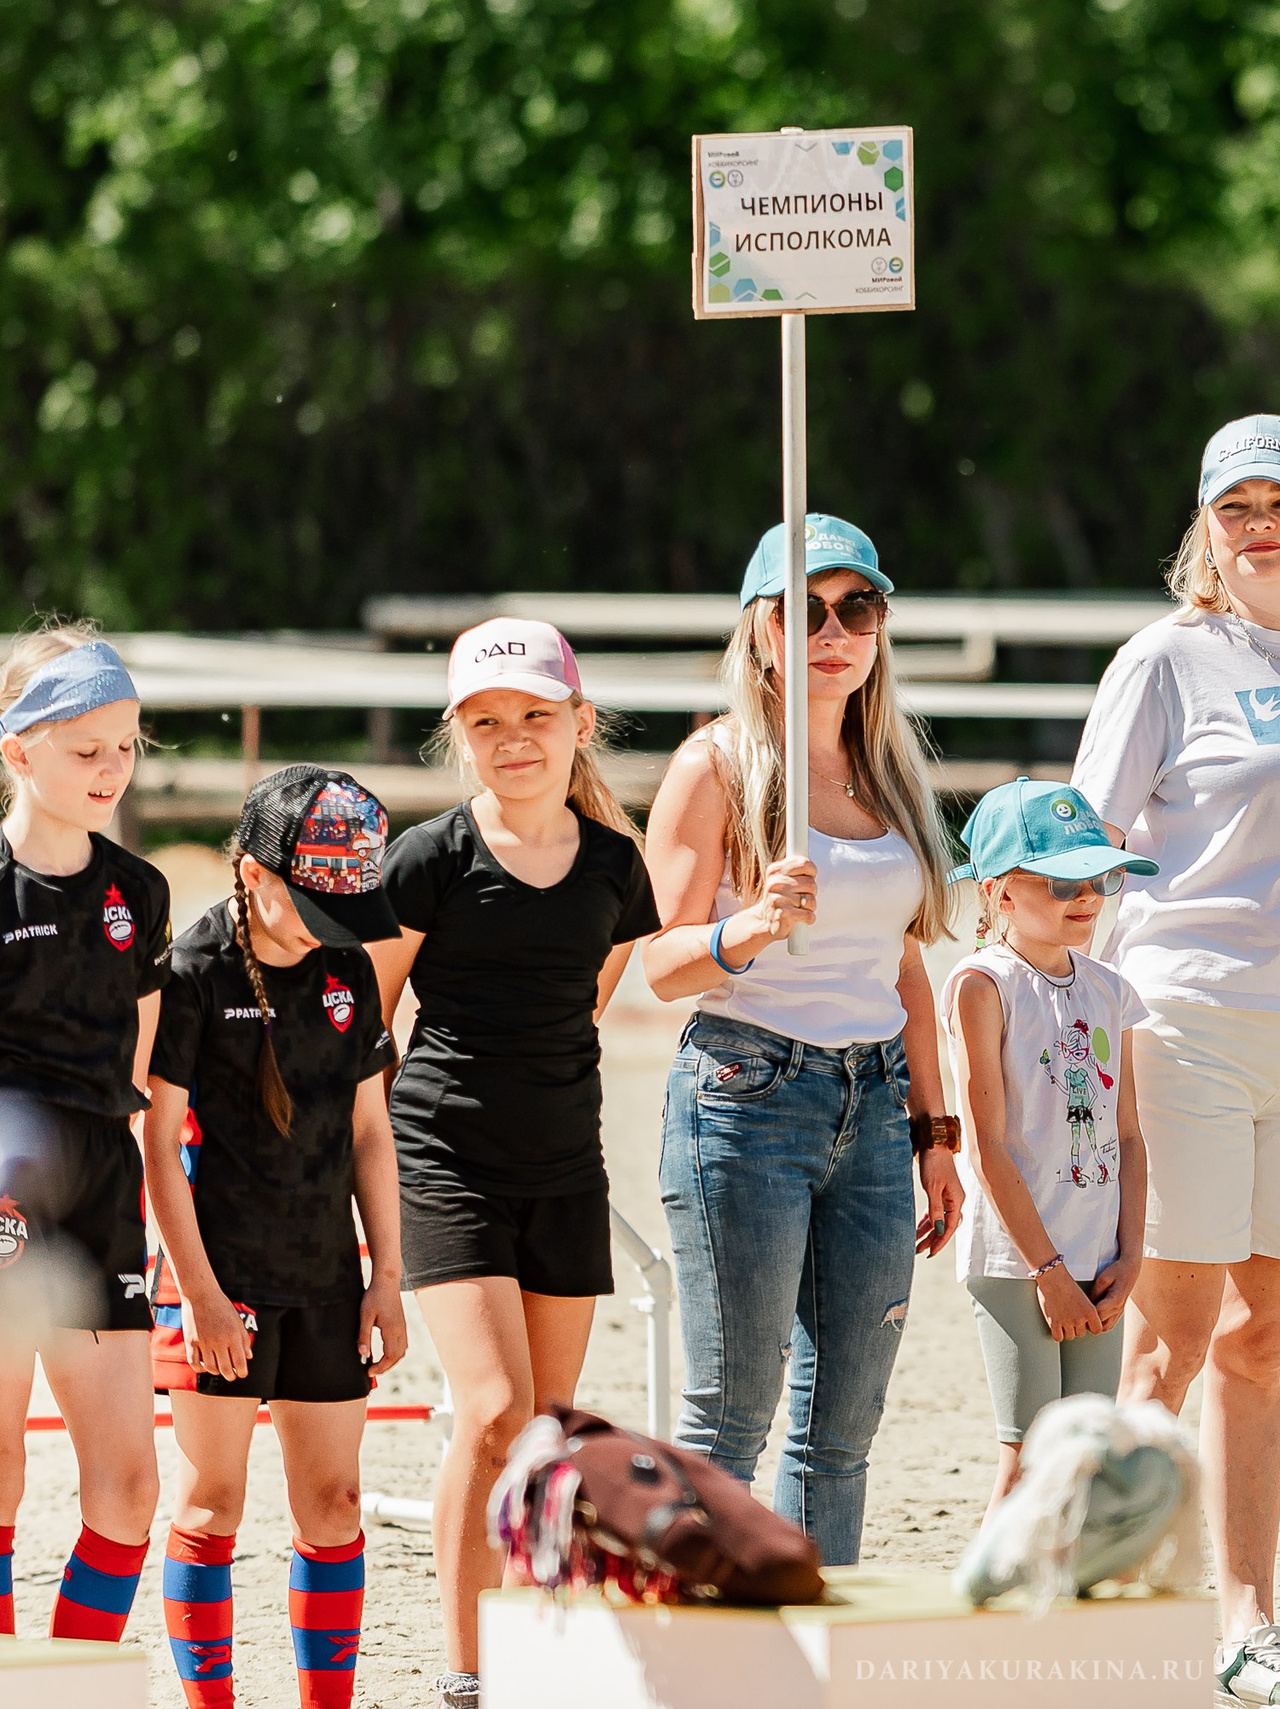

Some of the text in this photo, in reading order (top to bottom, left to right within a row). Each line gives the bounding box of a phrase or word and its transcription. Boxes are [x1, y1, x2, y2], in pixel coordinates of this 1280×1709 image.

[740, 192, 883, 216] ЧЕМПИОНЫ
[735, 228, 892, 252] ИСПОЛКОМА
[14, 924, 59, 941] PATRICK
[322, 990, 354, 1008] ЦСКА
